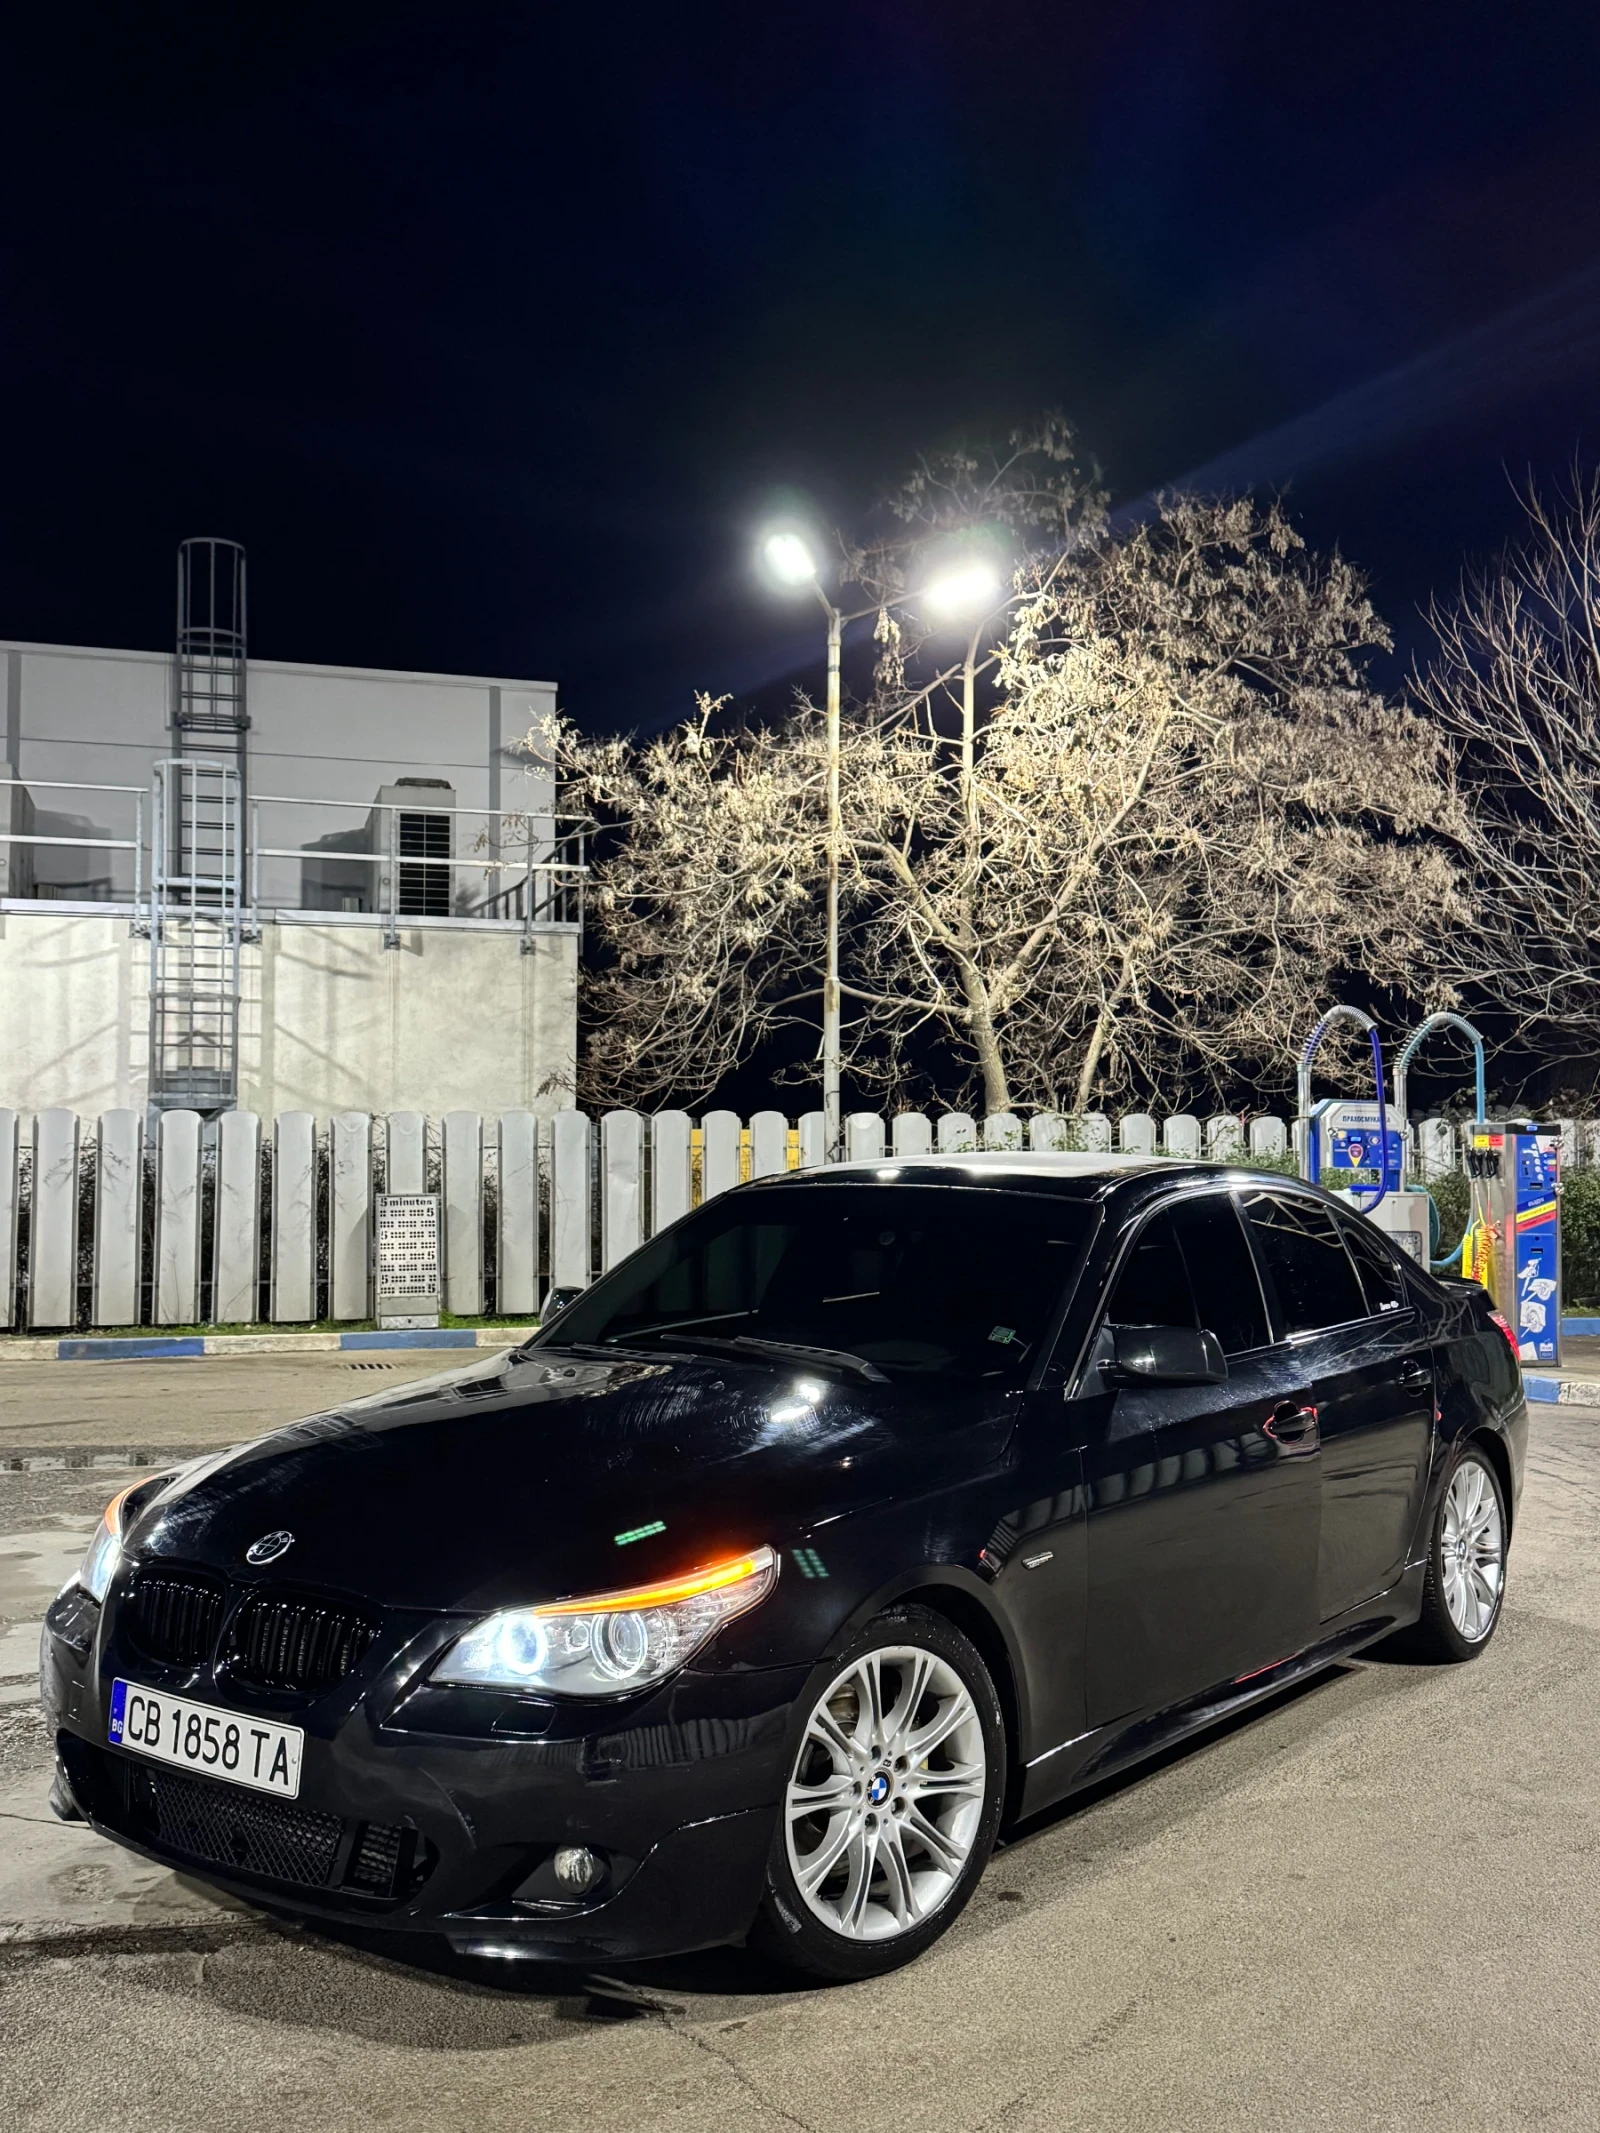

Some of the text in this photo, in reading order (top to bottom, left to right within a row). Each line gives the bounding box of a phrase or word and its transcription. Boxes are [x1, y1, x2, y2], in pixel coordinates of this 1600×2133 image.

[1342, 1115, 1391, 1123] ПРАХОСМУКАА
[380, 1197, 433, 1207] 5 minutes
[426, 1207, 434, 1217] 5
[380, 1230, 388, 1240] 5
[427, 1250, 435, 1260] 5
[381, 1274, 389, 1285] 5
[427, 1283, 436, 1293] 5
[111, 1718, 123, 1734] BG
[128, 1695, 289, 1786] CB 1858 TA
